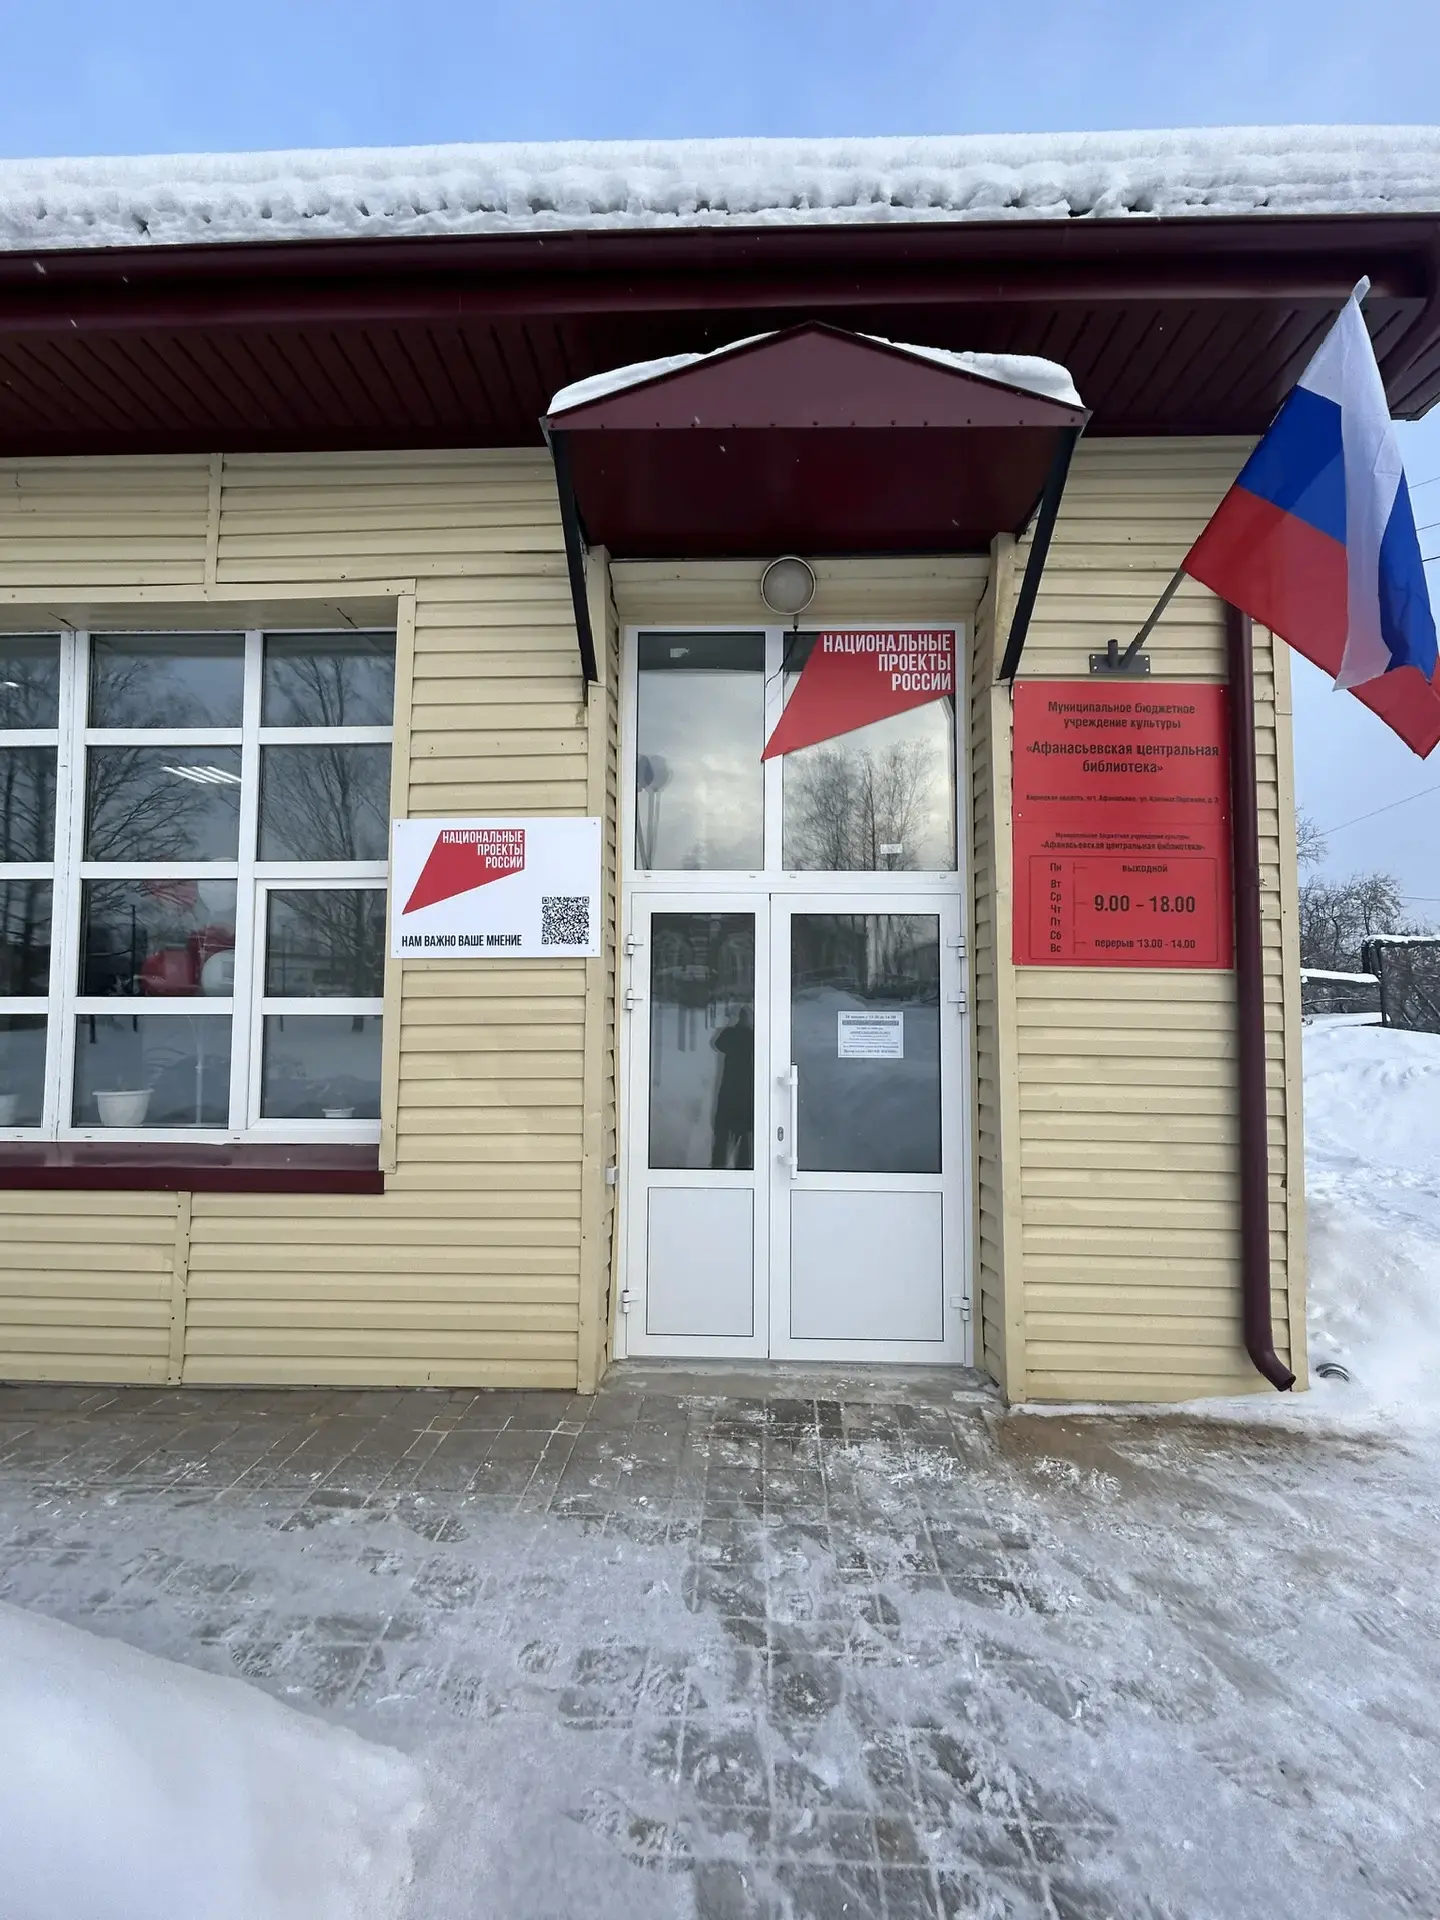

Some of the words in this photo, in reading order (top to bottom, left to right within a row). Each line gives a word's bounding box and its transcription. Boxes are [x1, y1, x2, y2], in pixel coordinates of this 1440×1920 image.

[823, 634, 951, 654] НАЦИОНАЛЬНЫЕ
[879, 653, 951, 672] ПРОЕКТЫ
[892, 673, 951, 691] РОССИИ
[1048, 701, 1131, 714] Муниципальное
[1135, 701, 1195, 715] бюджетное
[1064, 718, 1127, 729] учреждение
[1130, 719, 1181, 730] культуры
[1026, 741, 1133, 756] «Афанасьевская
[1137, 744, 1219, 758] центральная
[1083, 760, 1163, 773] библиотека»
[442, 830, 523, 844] НАЦИОНАЛЬНЫЕ
[477, 843, 523, 856] ПРОЕКТЫ
[485, 856, 523, 869] РОССИИ
[1050, 863, 1062, 872] Пн
[1122, 863, 1168, 874] выходной
[1050, 880, 1062, 889] Вт
[1050, 892, 1062, 903] Ср
[1094, 894, 1130, 912] 9.00
[1149, 895, 1196, 913] 18.00
[1050, 905, 1062, 914] Чт
[1050, 917, 1062, 926] Пт
[401, 935, 422, 947] НАМ
[424, 935, 456, 947] ВАЖНО
[458, 934, 483, 947] ВАШЕ
[486, 934, 522, 947] МНЕНИЕ
[1050, 930, 1062, 940] Сб
[1050, 944, 1062, 953] Вс
[1094, 940, 1134, 950] перерыв
[1138, 939, 1163, 949] 13.00
[1171, 939, 1196, 949] 14.00
